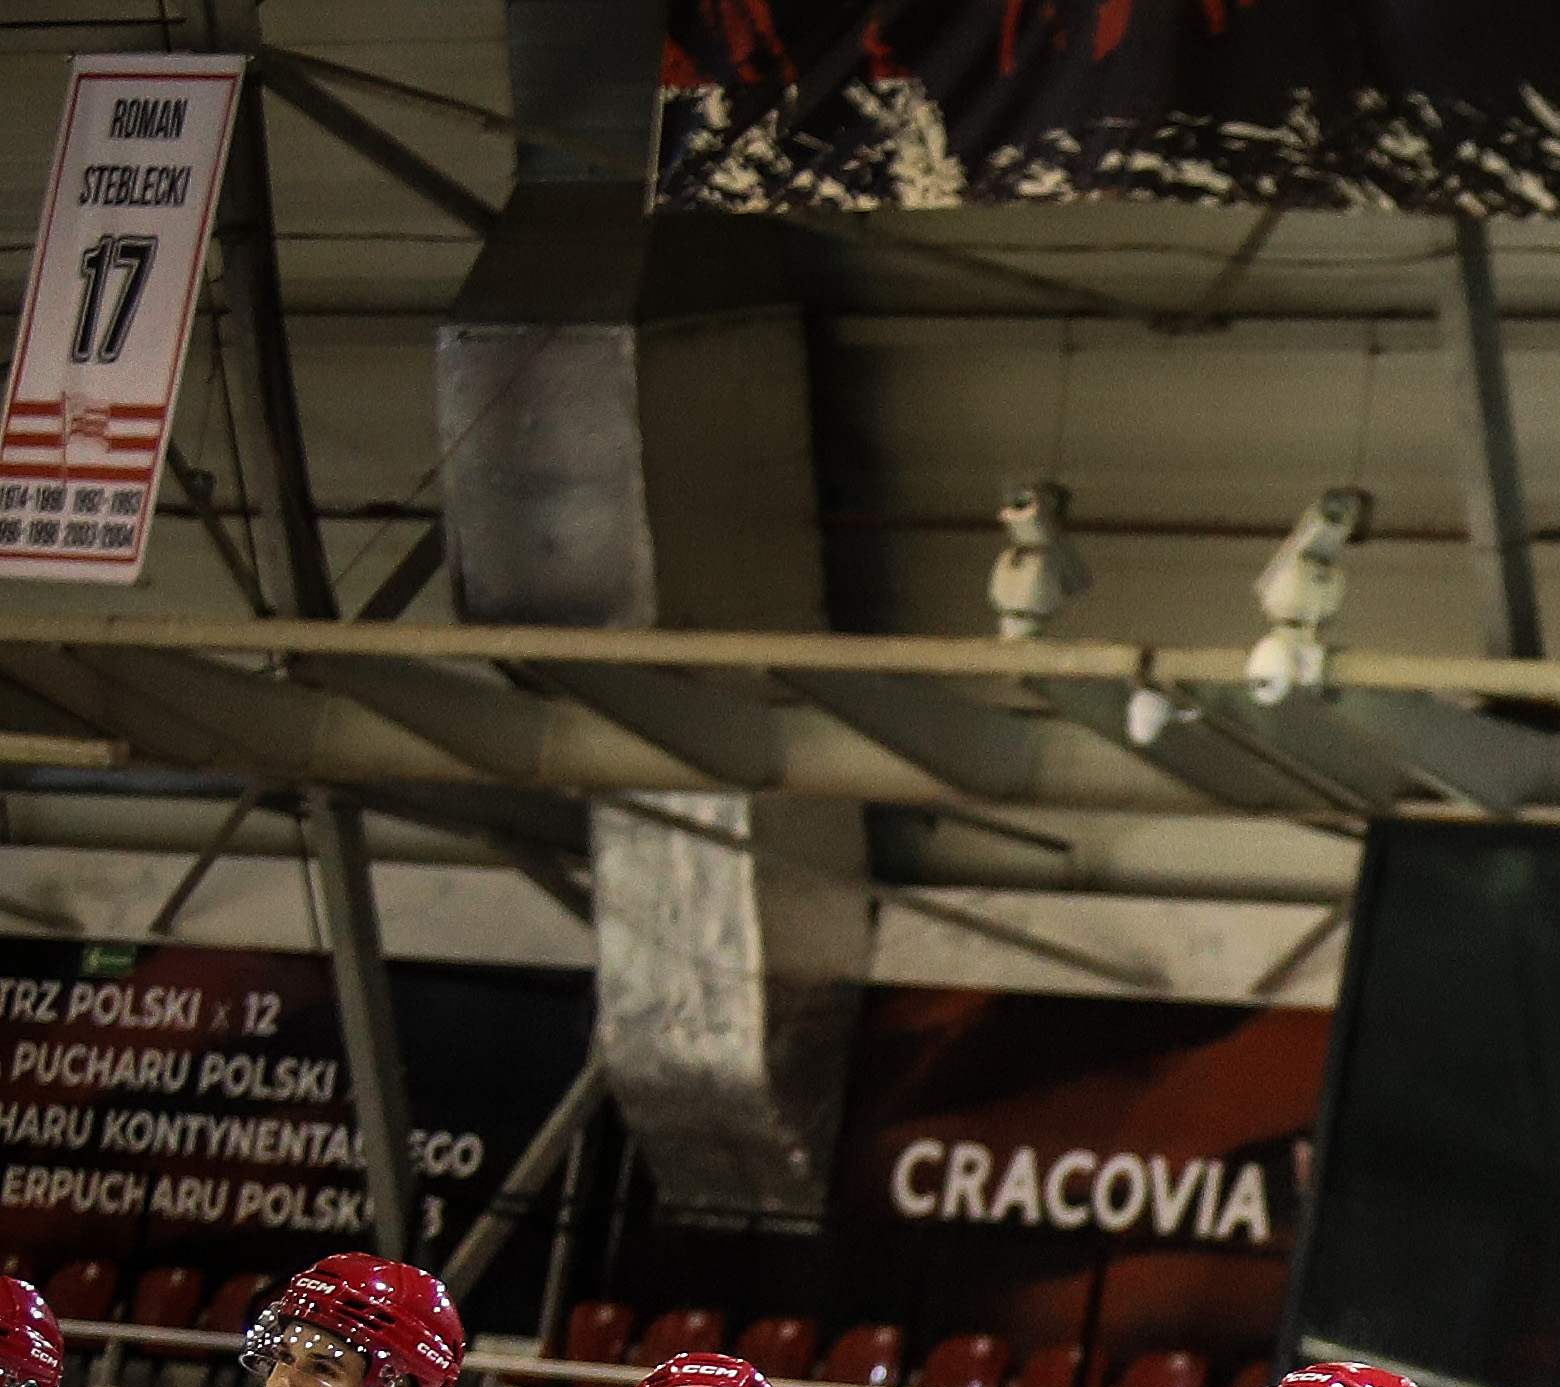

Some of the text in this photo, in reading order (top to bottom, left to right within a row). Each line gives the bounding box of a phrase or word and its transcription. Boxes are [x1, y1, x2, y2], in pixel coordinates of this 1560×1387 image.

[109, 98, 188, 138] ROMAN
[79, 164, 192, 205] STEBLECKI
[70, 235, 158, 365] 17
[66, 981, 203, 1030] POLSKI
[242, 991, 281, 1037] 12
[11, 1040, 338, 1103] PUCHARU POLSKI
[891, 1137, 1271, 1244] CRACOVIA
[296, 1277, 335, 1295] CCM
[30, 1347, 59, 1368] CCM
[416, 1341, 450, 1370] CCM
[682, 1365, 738, 1379] CCM
